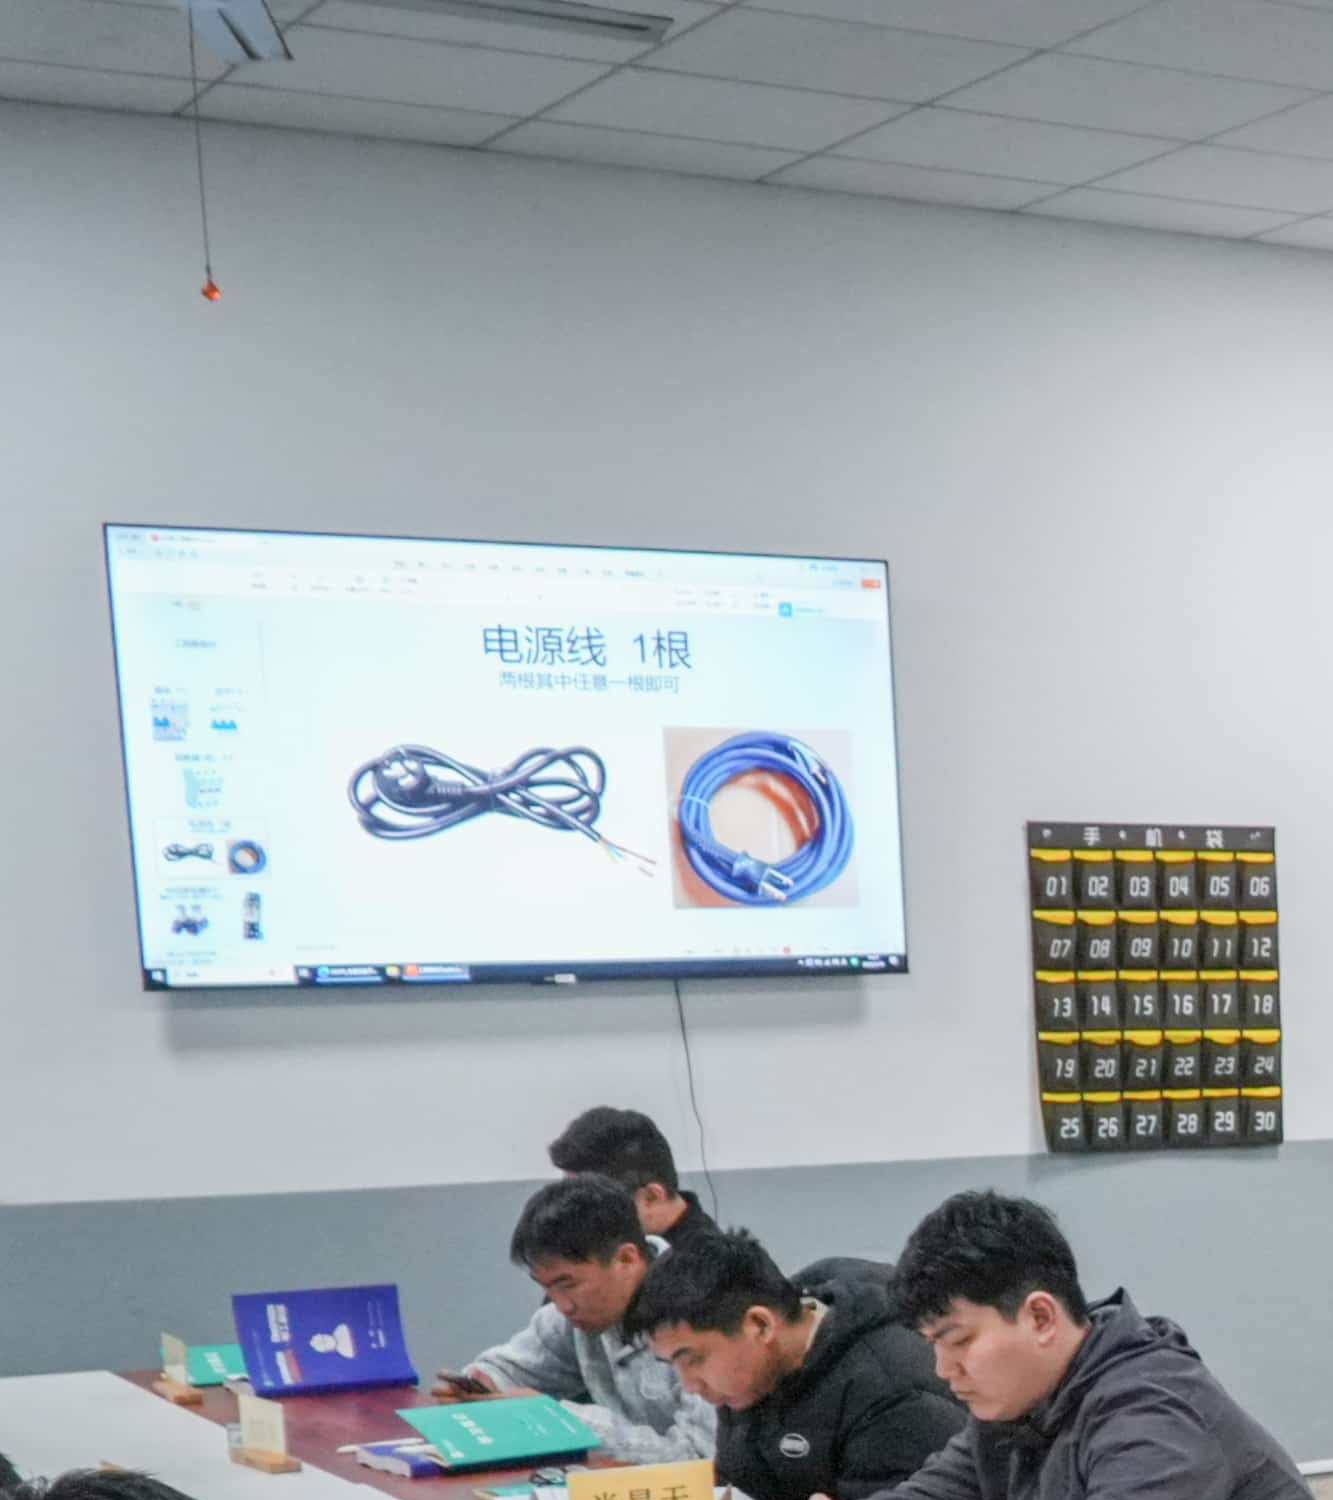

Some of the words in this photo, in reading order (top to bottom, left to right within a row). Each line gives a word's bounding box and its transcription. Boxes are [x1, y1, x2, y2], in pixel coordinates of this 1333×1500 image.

[482, 624, 607, 667] 电源线
[632, 628, 693, 669] 1根
[1046, 876, 1067, 897] 01
[1088, 876, 1108, 896] 02
[1130, 877, 1149, 896] 03
[1169, 876, 1189, 896] 04
[1210, 876, 1230, 896] 05
[1250, 877, 1270, 896] 06
[1050, 939, 1071, 958] 07
[1090, 939, 1110, 958] 08
[1131, 938, 1151, 957] 09
[1172, 938, 1192, 957] 10
[1211, 938, 1232, 957] 11
[1251, 938, 1271, 957] 12
[1053, 998, 1072, 1017] 13
[1091, 996, 1111, 1014] 14
[1133, 995, 1153, 1015] 15
[1173, 995, 1193, 1015] 16
[1211, 994, 1232, 1014] 17
[1253, 995, 1273, 1014] 18
[1056, 1059, 1074, 1077] 19
[1094, 1059, 1115, 1077] 20
[1136, 1059, 1156, 1077] 21
[1174, 1057, 1194, 1076] 22
[1214, 1057, 1235, 1074] 23
[1254, 1056, 1274, 1074] 24
[1060, 1119, 1080, 1138] 25
[1098, 1117, 1118, 1137] 26
[1136, 1115, 1156, 1134] 27
[1177, 1114, 1198, 1134] 28
[1214, 1112, 1235, 1131] 29
[1255, 1112, 1275, 1131] 30
